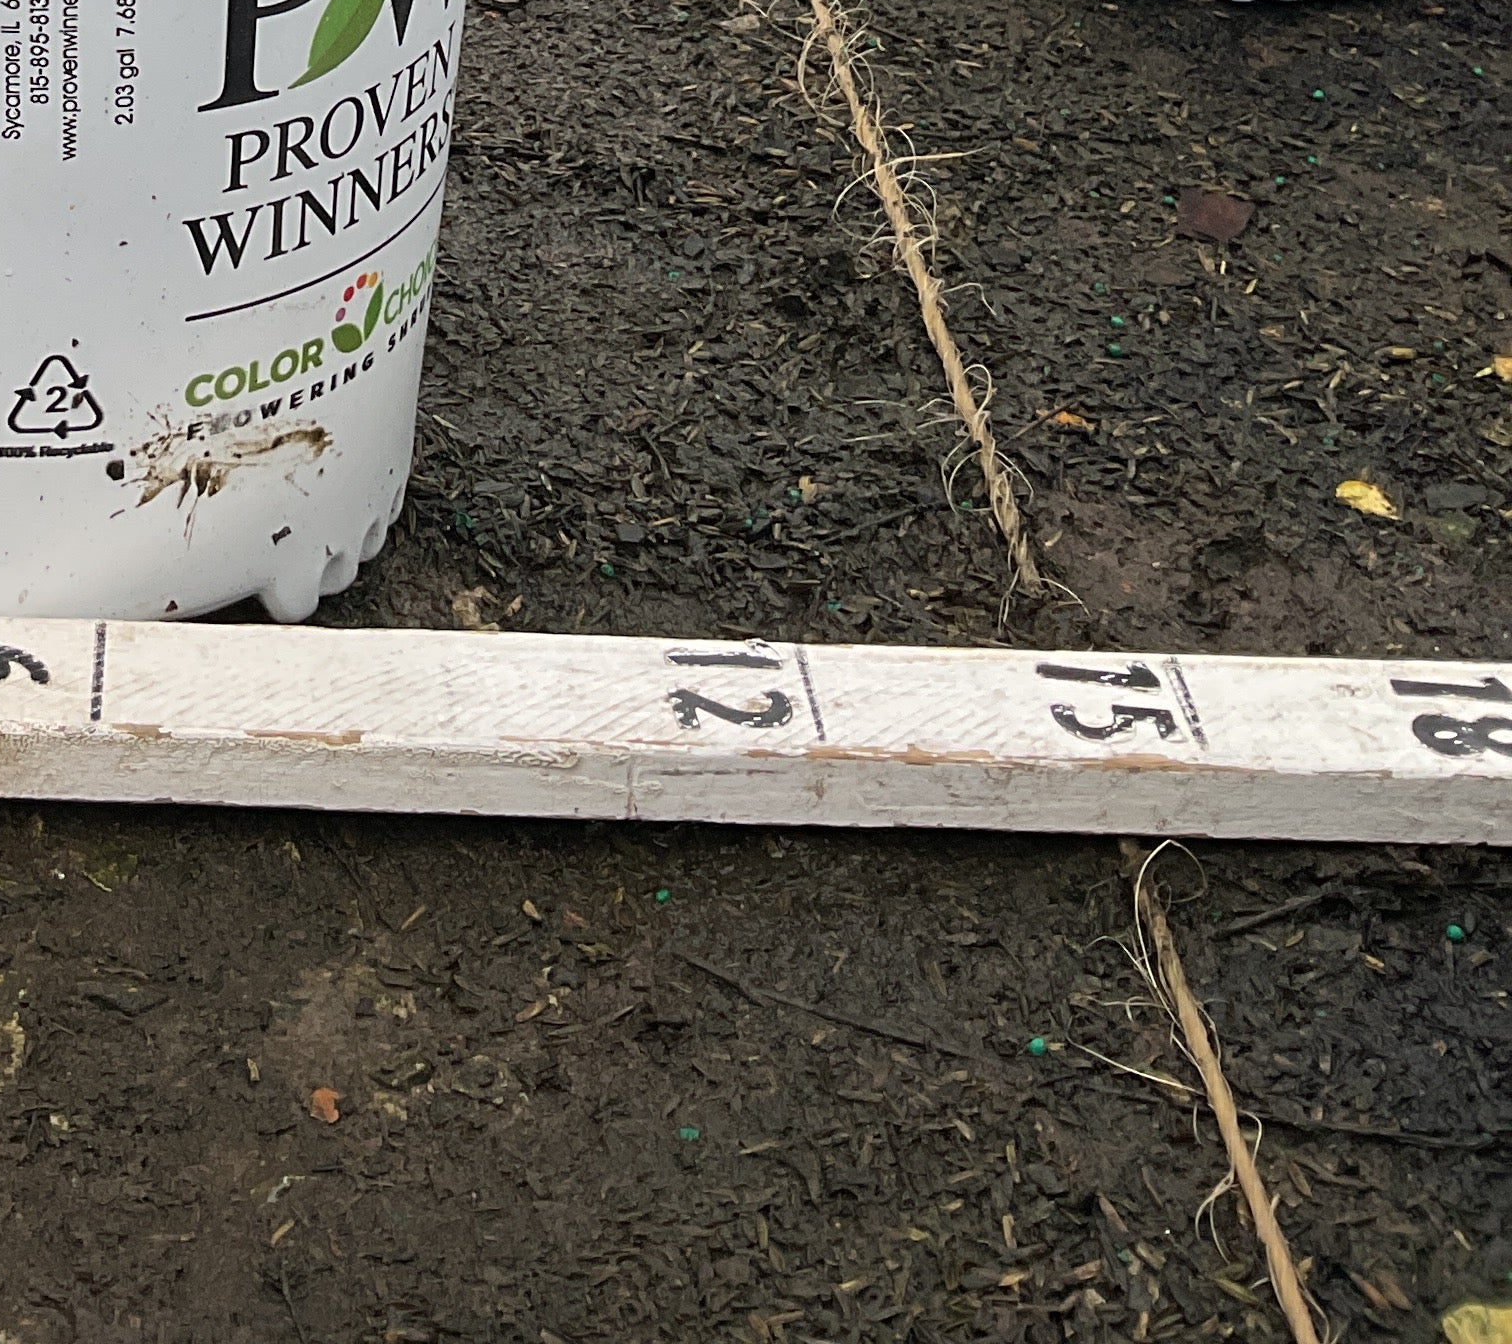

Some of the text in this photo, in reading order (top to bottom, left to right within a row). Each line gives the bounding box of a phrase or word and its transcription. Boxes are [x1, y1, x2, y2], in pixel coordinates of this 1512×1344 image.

[0, 20, 21, 34] IL
[116, 48, 140, 78] gal
[1, 40, 25, 140] Sycamore,
[114, 84, 135, 125] 2.03
[221, 20, 456, 193] PROVEN
[45, 385, 70, 413] 2
[185, 337, 326, 409] COLOR
[665, 638, 793, 730] 12
[1035, 660, 1183, 742] 15
[1389, 676, 1512, 758] 18
